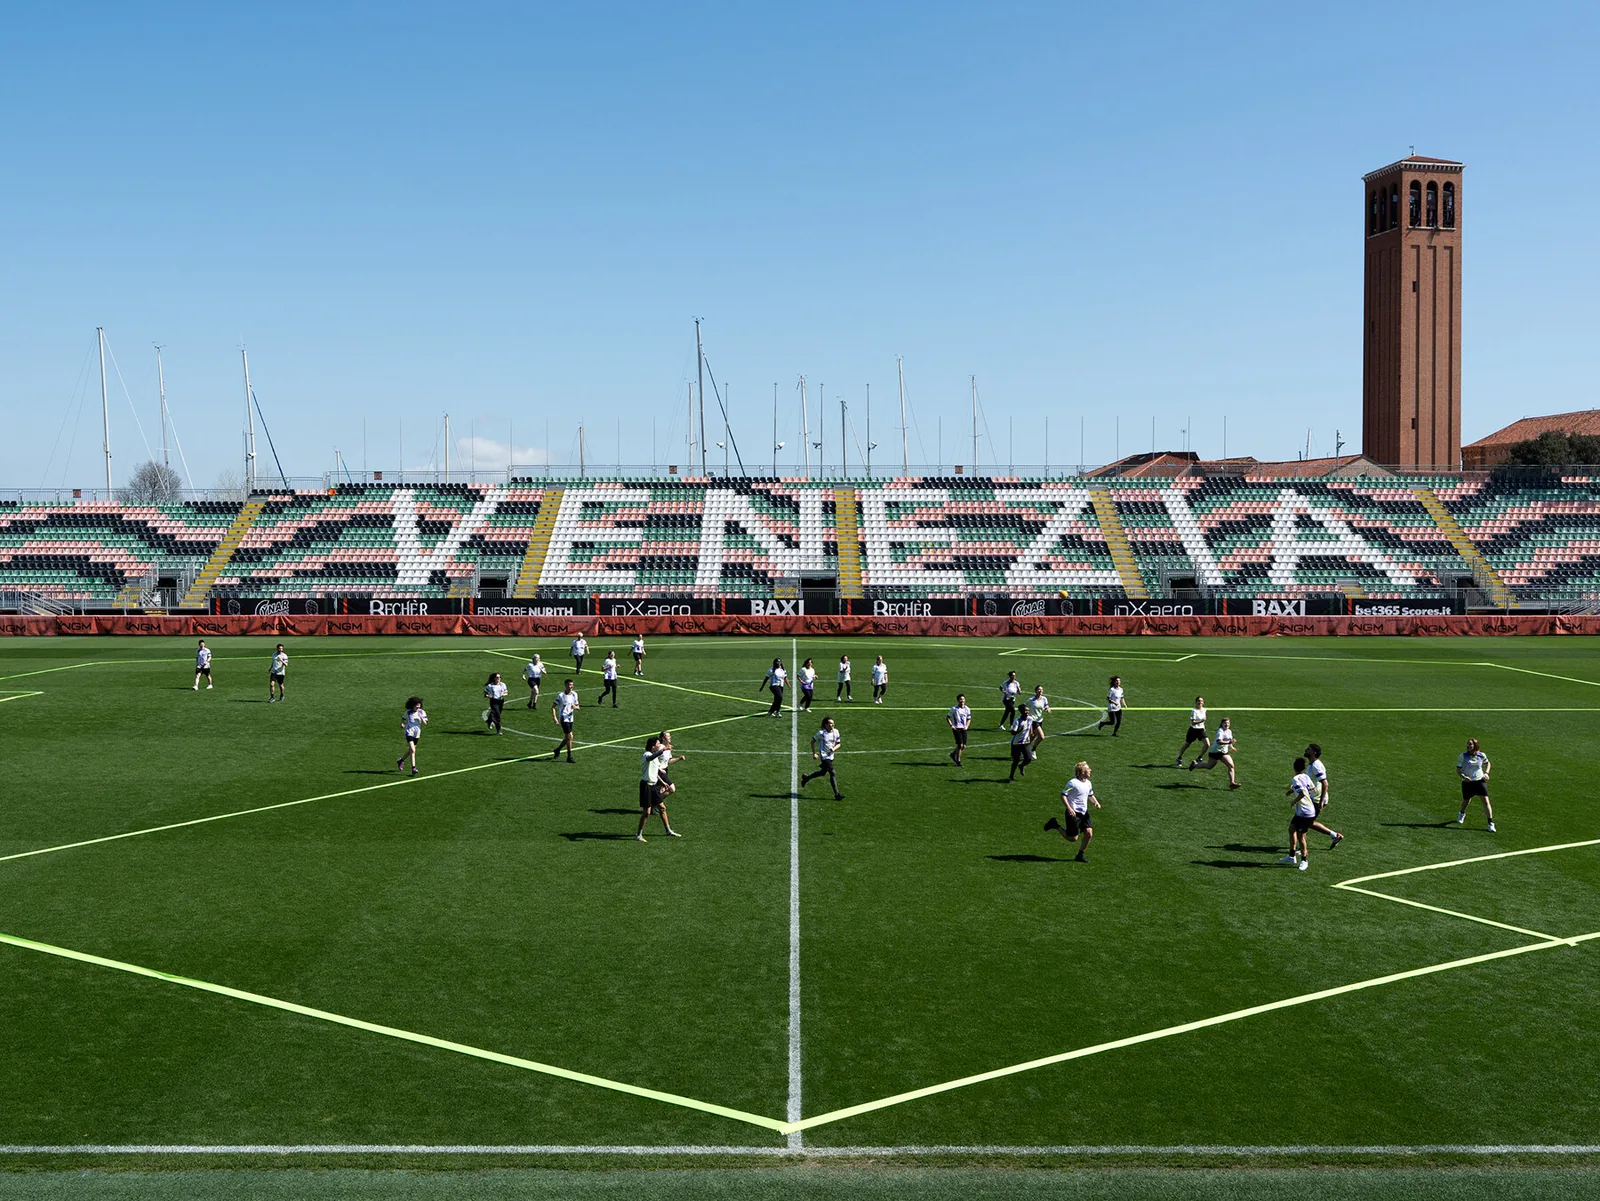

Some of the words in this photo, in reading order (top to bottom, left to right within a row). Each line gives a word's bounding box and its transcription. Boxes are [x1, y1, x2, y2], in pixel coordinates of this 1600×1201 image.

[255, 599, 289, 615] CYNAR
[477, 607, 527, 615] FINESTRE
[529, 607, 574, 615] NURITH
[750, 600, 804, 615] BAXI
[1011, 599, 1045, 616] CYNAR
[1252, 600, 1306, 615] BAXI
[1355, 605, 1400, 615] bet365
[1402, 606, 1451, 615] Scores.it
[61, 621, 91, 630] NGM
[129, 623, 161, 631] NGM
[265, 623, 296, 631] NGM
[332, 622, 362, 630] NGM
[400, 622, 431, 630] NGM
[538, 623, 568, 632] NGM
[604, 622, 635, 631] NGM
[674, 621, 704, 630] NGM
[742, 621, 771, 630] NGM
[809, 622, 841, 631] NGM
[878, 622, 908, 631] NGM
[946, 623, 977, 632] NGM
[1013, 622, 1044, 631] NGM
[1082, 622, 1113, 631] NGM
[1149, 622, 1179, 631] NGM
[1216, 624, 1247, 633] NGM
[1284, 623, 1314, 632] NGM
[1351, 623, 1383, 631] NGM
[1418, 623, 1449, 632] NGM
[1487, 623, 1517, 632] NGM
[1553, 622, 1582, 631] NGM
